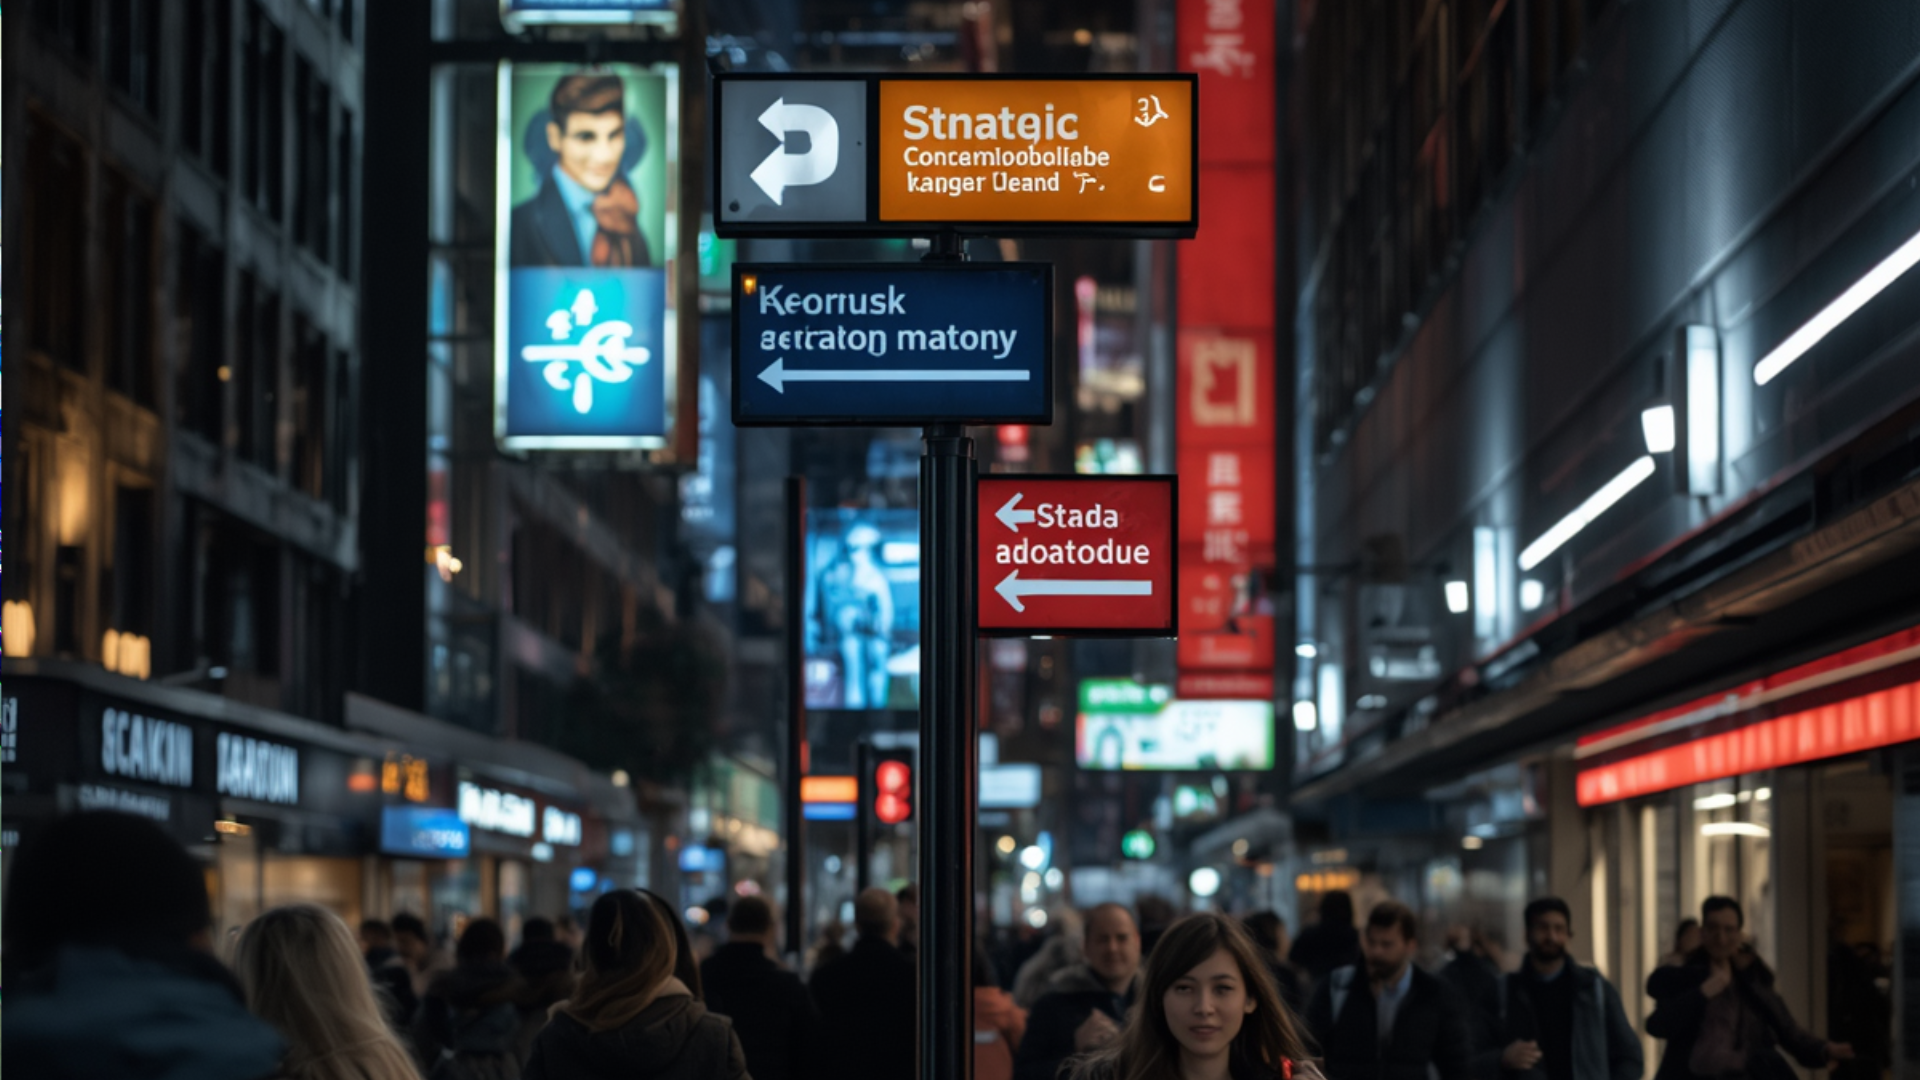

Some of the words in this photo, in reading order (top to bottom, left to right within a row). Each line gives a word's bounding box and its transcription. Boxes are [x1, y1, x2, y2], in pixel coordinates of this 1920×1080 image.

[897, 324, 1018, 360] matony
[1037, 503, 1119, 529] Stada
[995, 537, 1150, 565] adoatodue
